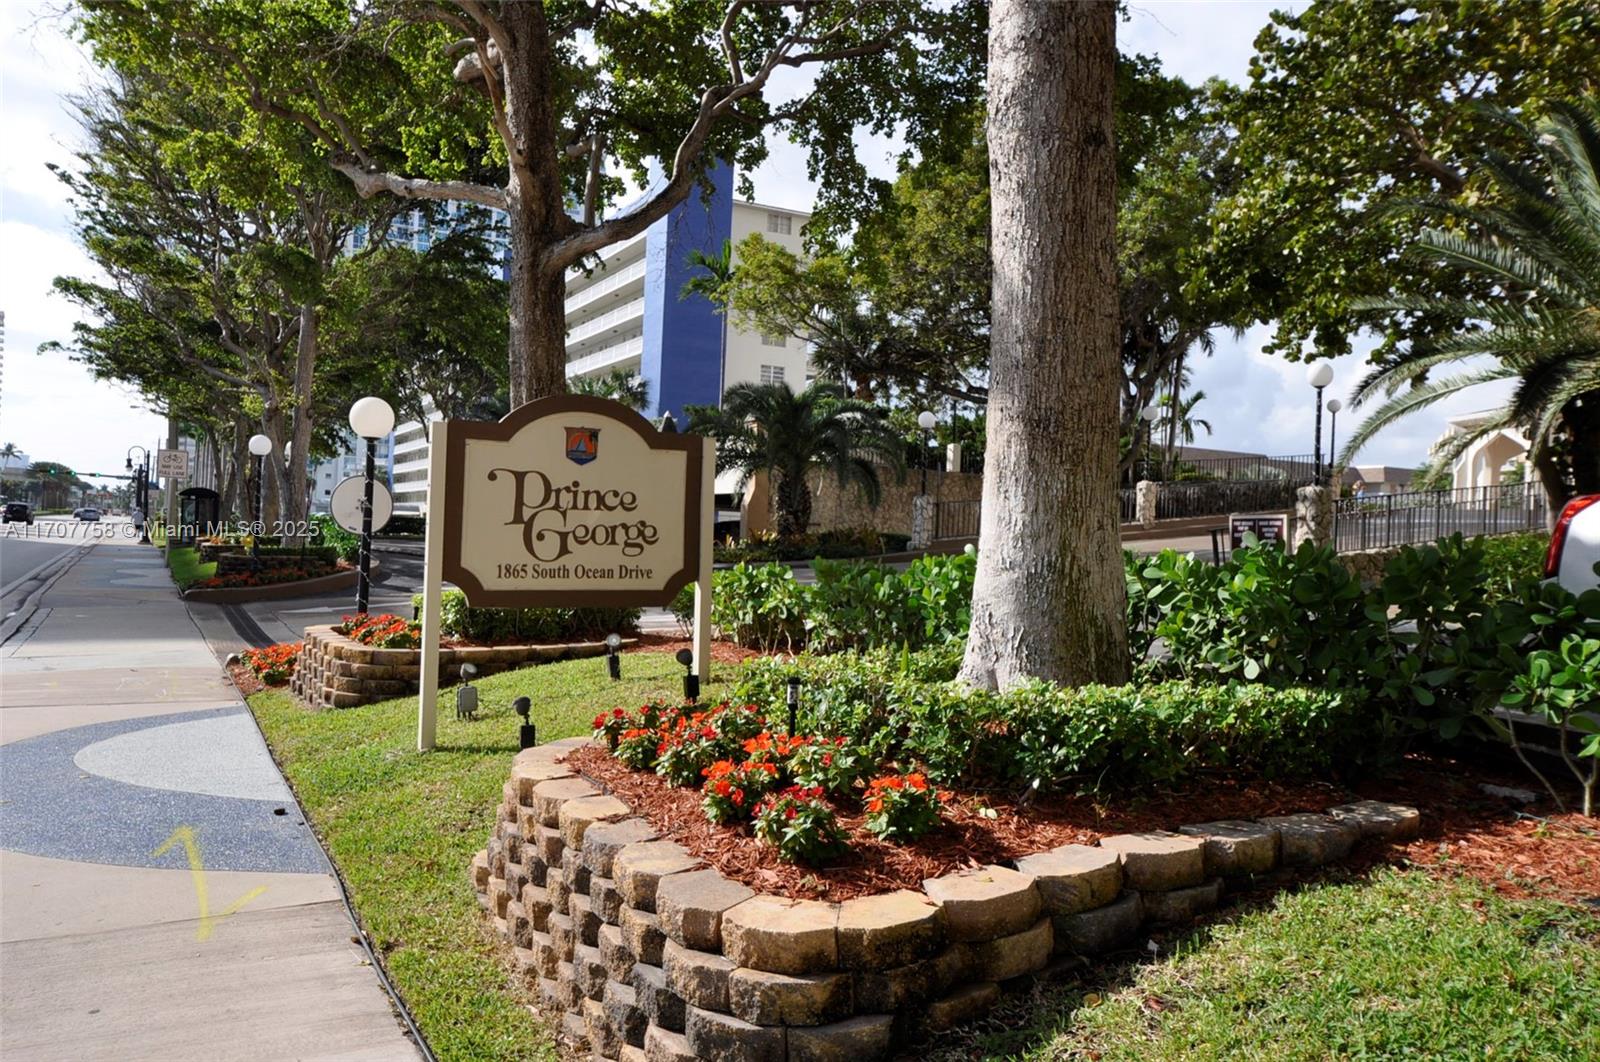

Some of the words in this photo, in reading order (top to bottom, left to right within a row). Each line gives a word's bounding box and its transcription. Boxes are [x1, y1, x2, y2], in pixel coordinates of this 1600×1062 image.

[487, 468, 638, 525] Prince
[522, 508, 660, 563] George
[496, 563, 528, 579] 1865
[531, 563, 570, 579] South
[574, 564, 614, 579] Ocean
[618, 564, 653, 579] Drive
